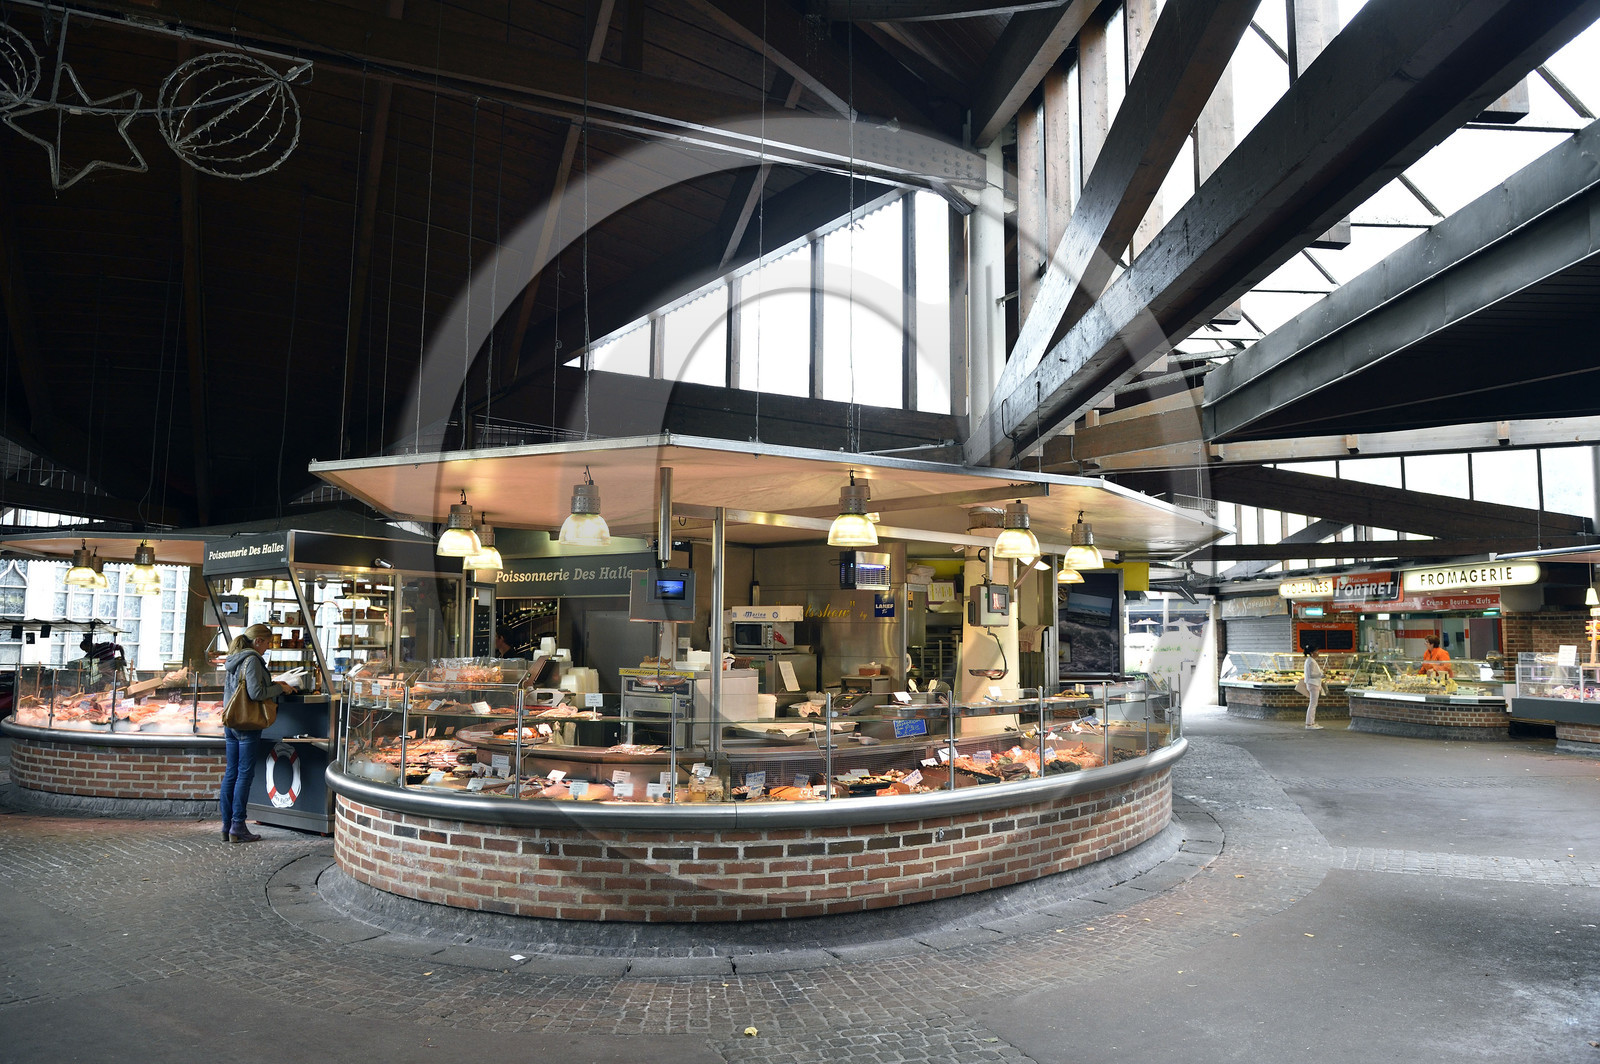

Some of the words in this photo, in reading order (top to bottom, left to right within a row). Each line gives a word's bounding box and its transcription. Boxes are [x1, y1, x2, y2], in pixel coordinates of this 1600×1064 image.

[208, 546, 248, 560] Poissonnerie
[249, 546, 261, 556] Des
[262, 543, 284, 555] Halles
[495, 568, 570, 583] Poissonnerie
[573, 568, 596, 581] Des
[1420, 567, 1512, 585] FROMAGERIE
